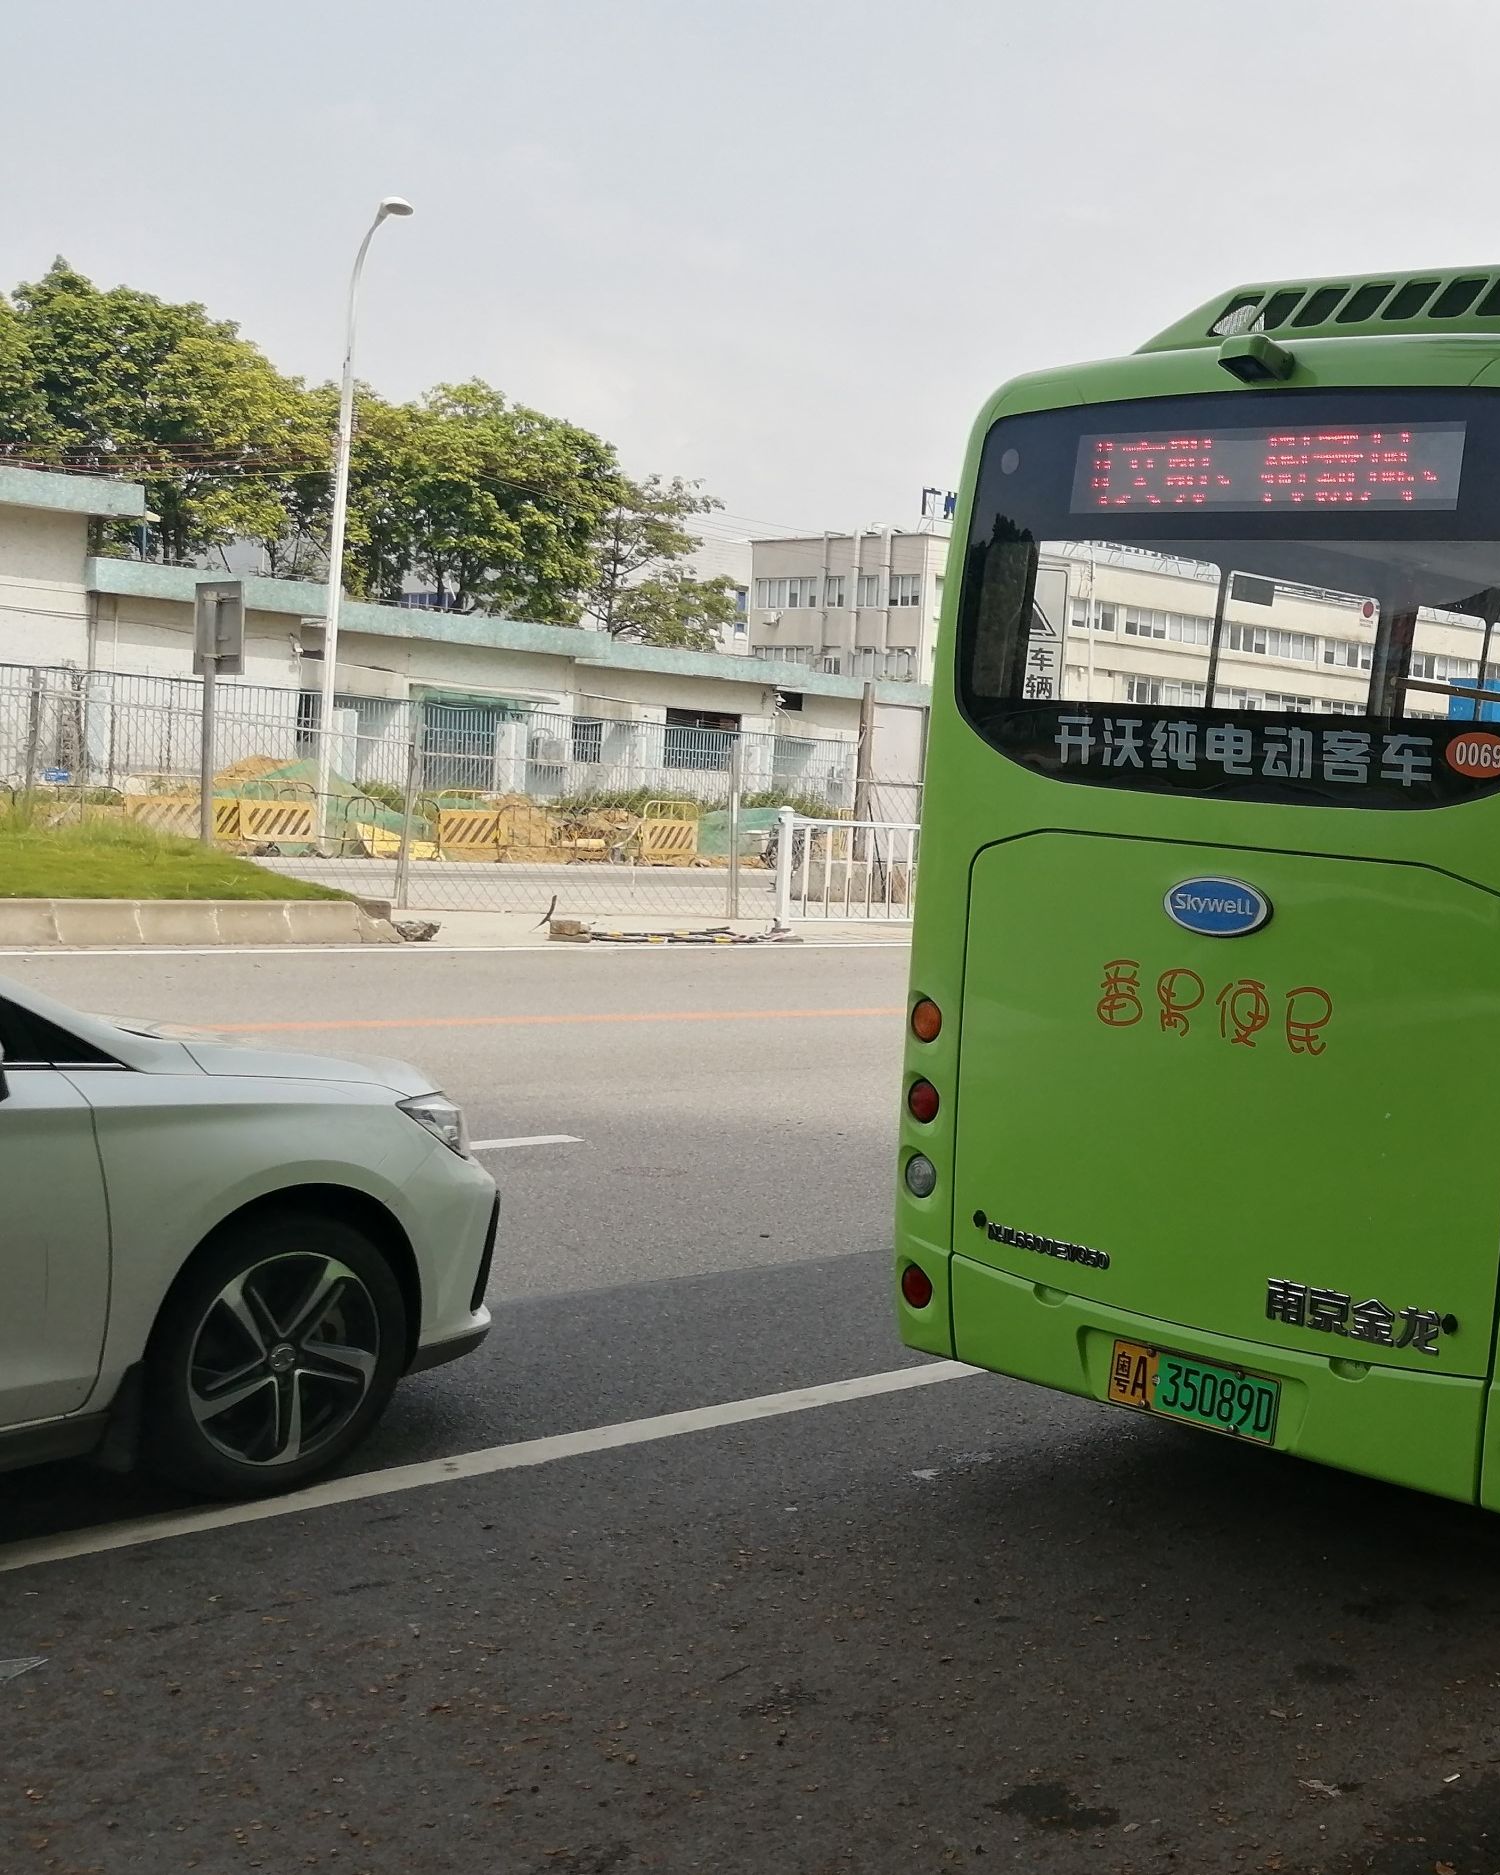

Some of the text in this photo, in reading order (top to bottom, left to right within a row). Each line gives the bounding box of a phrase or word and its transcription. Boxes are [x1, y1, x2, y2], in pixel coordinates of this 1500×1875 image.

[1054, 716, 1432, 786] 开沃纯电动客车
[1174, 893, 1253, 914] Skywell
[1097, 960, 1333, 1056] 番禺便民
[1266, 1277, 1440, 1355] 南京金龙
[1114, 1351, 1274, 1433] 粤A 35089D
